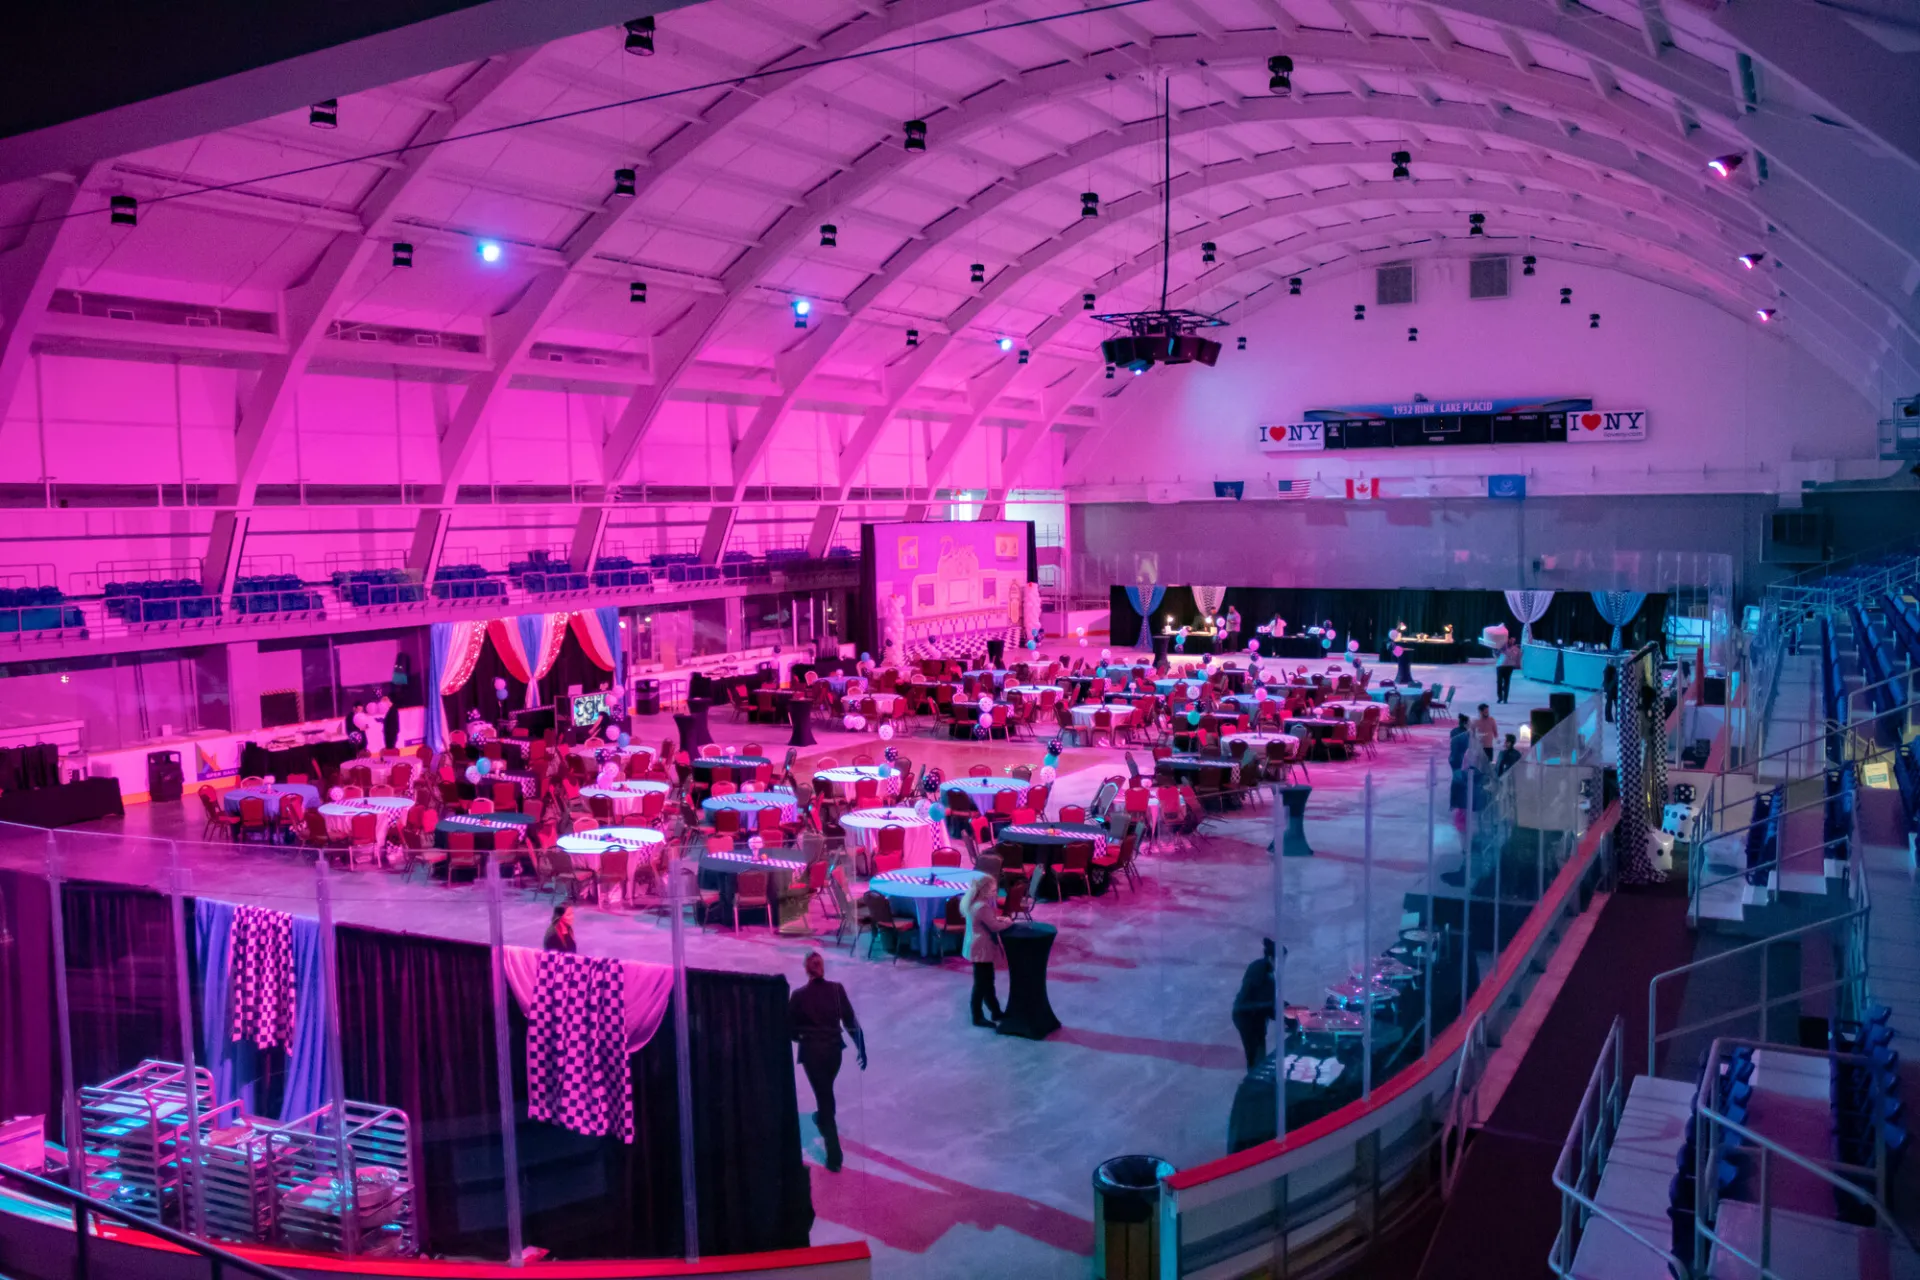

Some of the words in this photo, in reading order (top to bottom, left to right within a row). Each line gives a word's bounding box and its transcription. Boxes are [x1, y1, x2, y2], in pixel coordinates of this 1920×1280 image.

[1393, 404, 1412, 415] 1932
[1414, 403, 1435, 414] RINK
[1440, 402, 1461, 413] LAKE
[1463, 401, 1493, 412] PLACID
[1569, 413, 1580, 431] I
[1603, 411, 1645, 430] NY
[1259, 426, 1268, 442] I
[1287, 424, 1322, 441] NY
